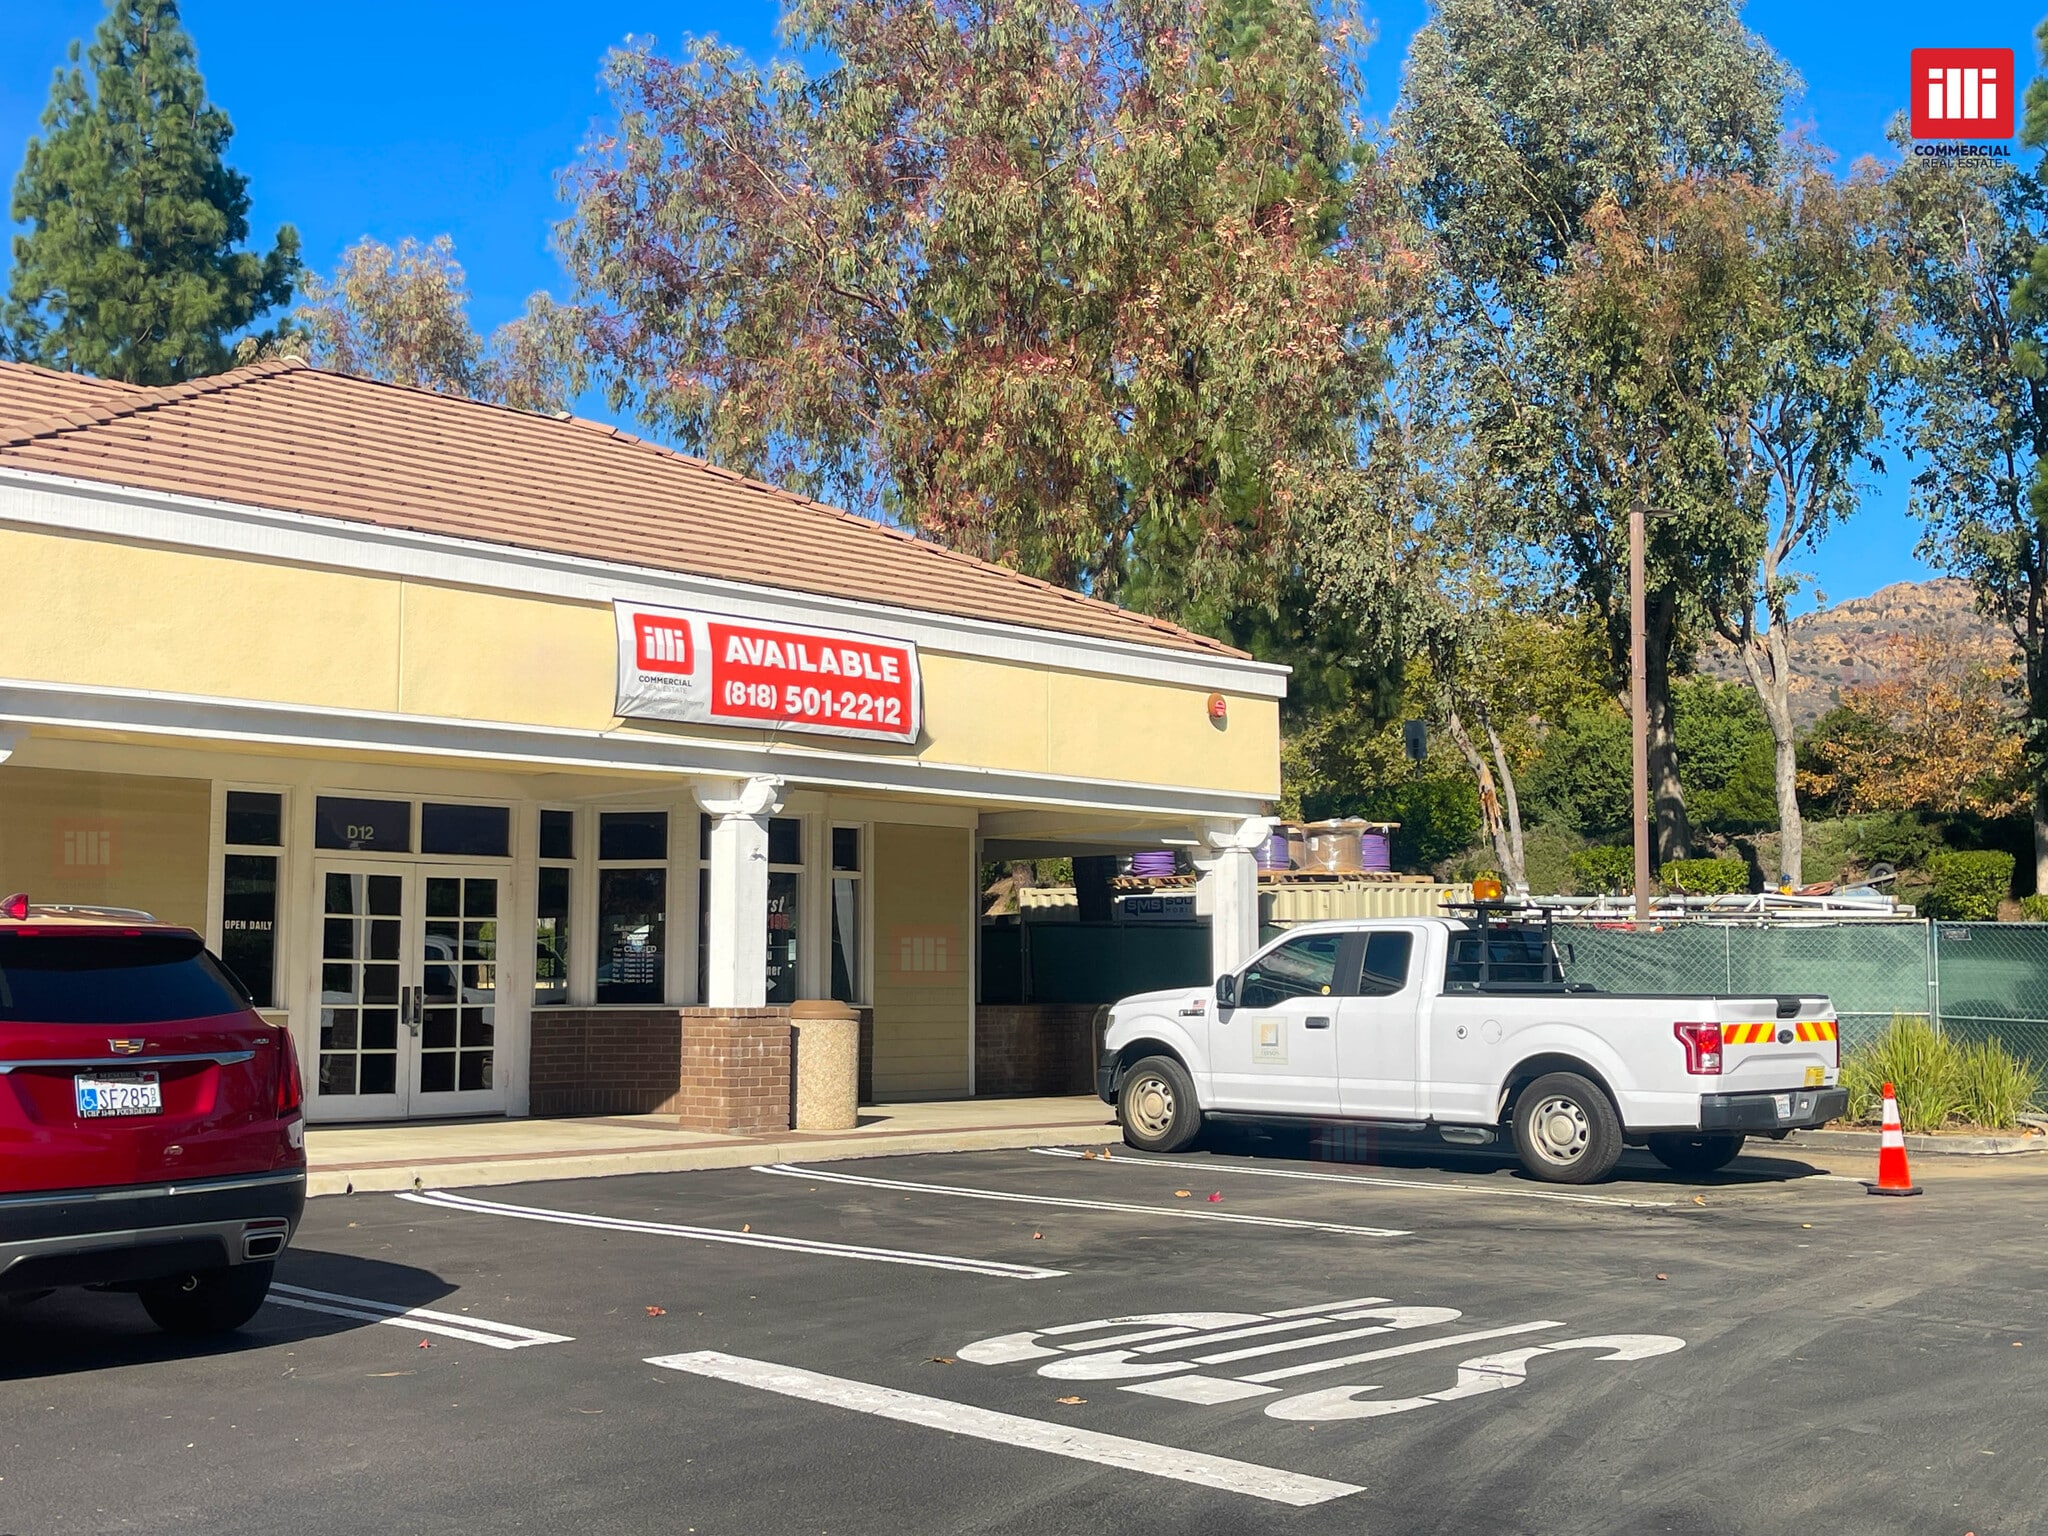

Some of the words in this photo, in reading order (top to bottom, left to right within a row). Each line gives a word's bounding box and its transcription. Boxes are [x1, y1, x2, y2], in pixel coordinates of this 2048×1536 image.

[643, 625, 686, 663] illi
[725, 635, 901, 684] AVAILABLE
[638, 675, 693, 687] COMMERCIAL
[662, 685, 688, 694] ESTATE
[725, 680, 777, 710] (818)
[785, 685, 902, 725] 501-2212
[347, 824, 375, 840] D12
[1127, 899, 1161, 911] SMS
[224, 919, 247, 930] OPEN
[249, 920, 273, 931] DAILY
[623, 945, 657, 953] CLSED
[99, 1087, 151, 1109] SF285
